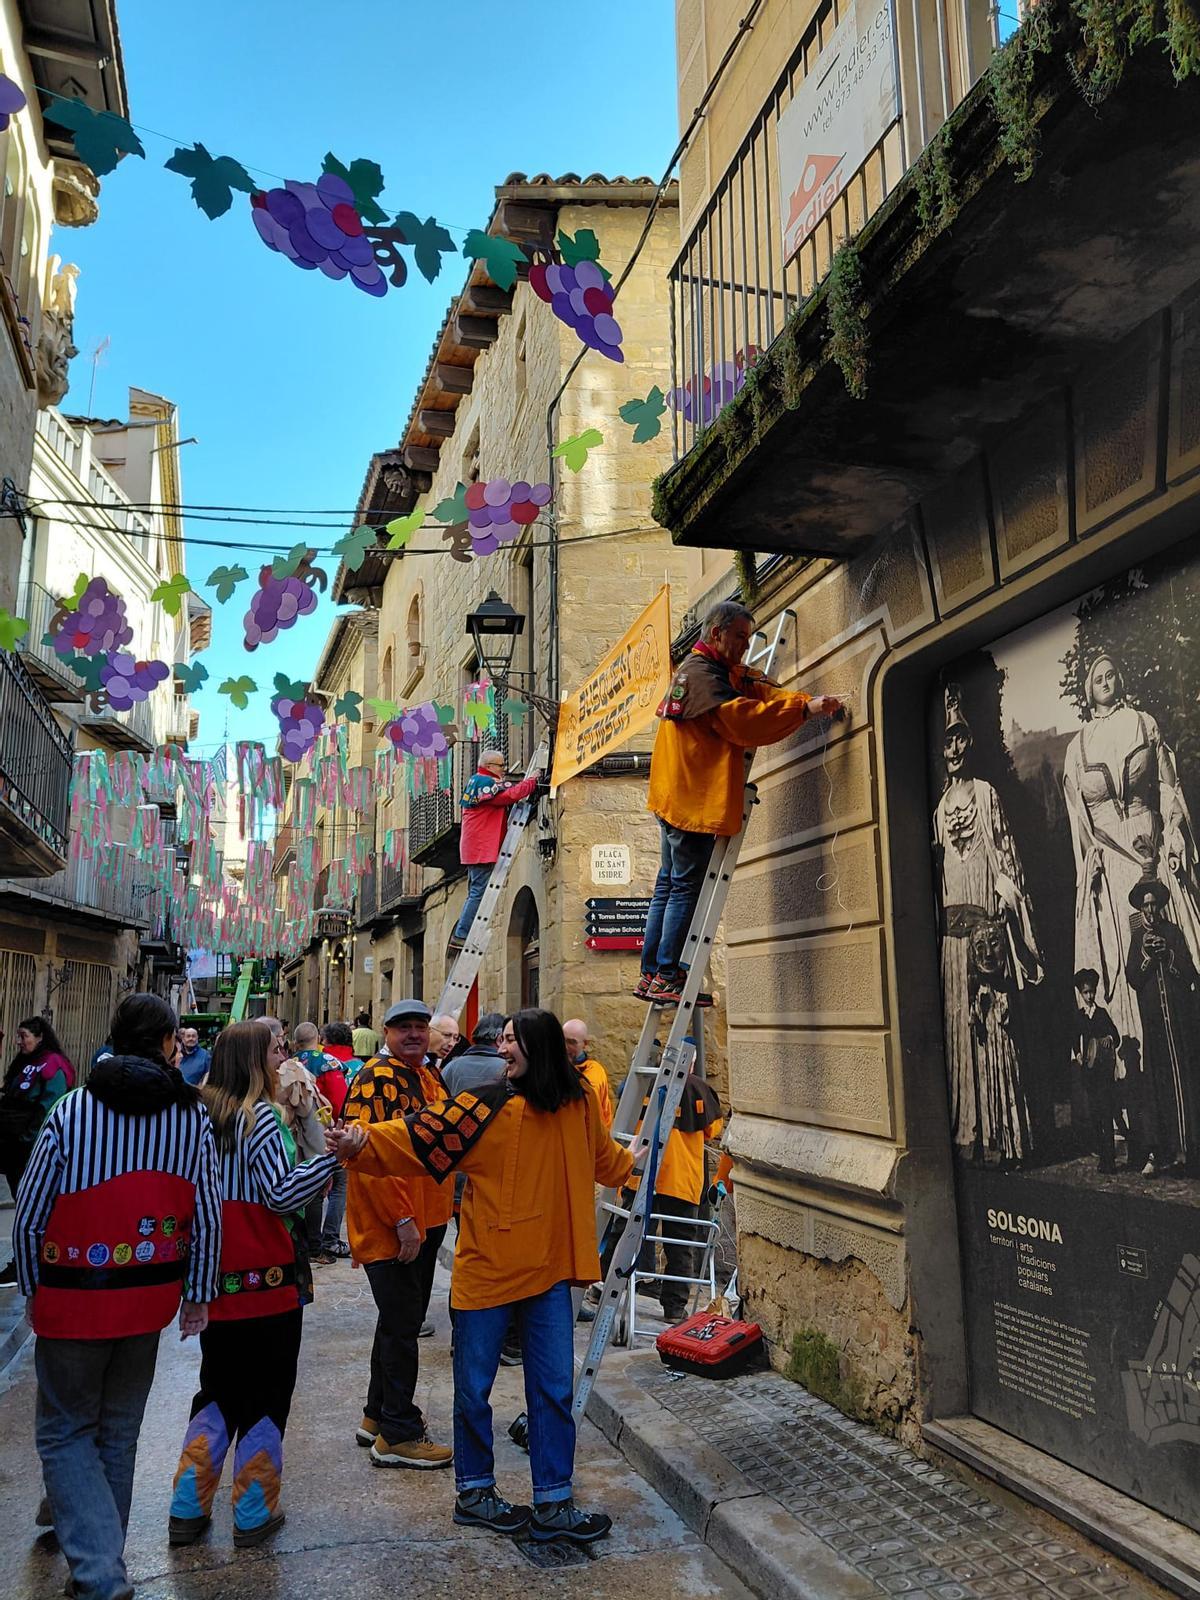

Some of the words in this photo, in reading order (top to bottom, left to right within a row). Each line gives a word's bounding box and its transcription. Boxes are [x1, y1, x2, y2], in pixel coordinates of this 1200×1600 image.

[802, 1, 889, 138] www.ladier.es
[835, 89, 851, 112] 973
[852, 66, 865, 88] 48
[864, 47, 879, 71] 33
[879, 22, 892, 46] 30
[783, 168, 844, 260] Ladier
[595, 860, 605, 868] DE
[607, 860, 626, 868] SANT
[598, 850, 622, 859] PLAÇA
[598, 870, 623, 879] ISIDRE
[598, 926, 621, 934] Imagine
[987, 1208, 1063, 1244] SOLSONA
[990, 1234, 1014, 1248] territori
[1019, 1241, 1034, 1254] arts
[1020, 1253, 1057, 1272] tradicions
[1017, 1265, 1049, 1283] populars
[1018, 1277, 1053, 1296] catalanes
